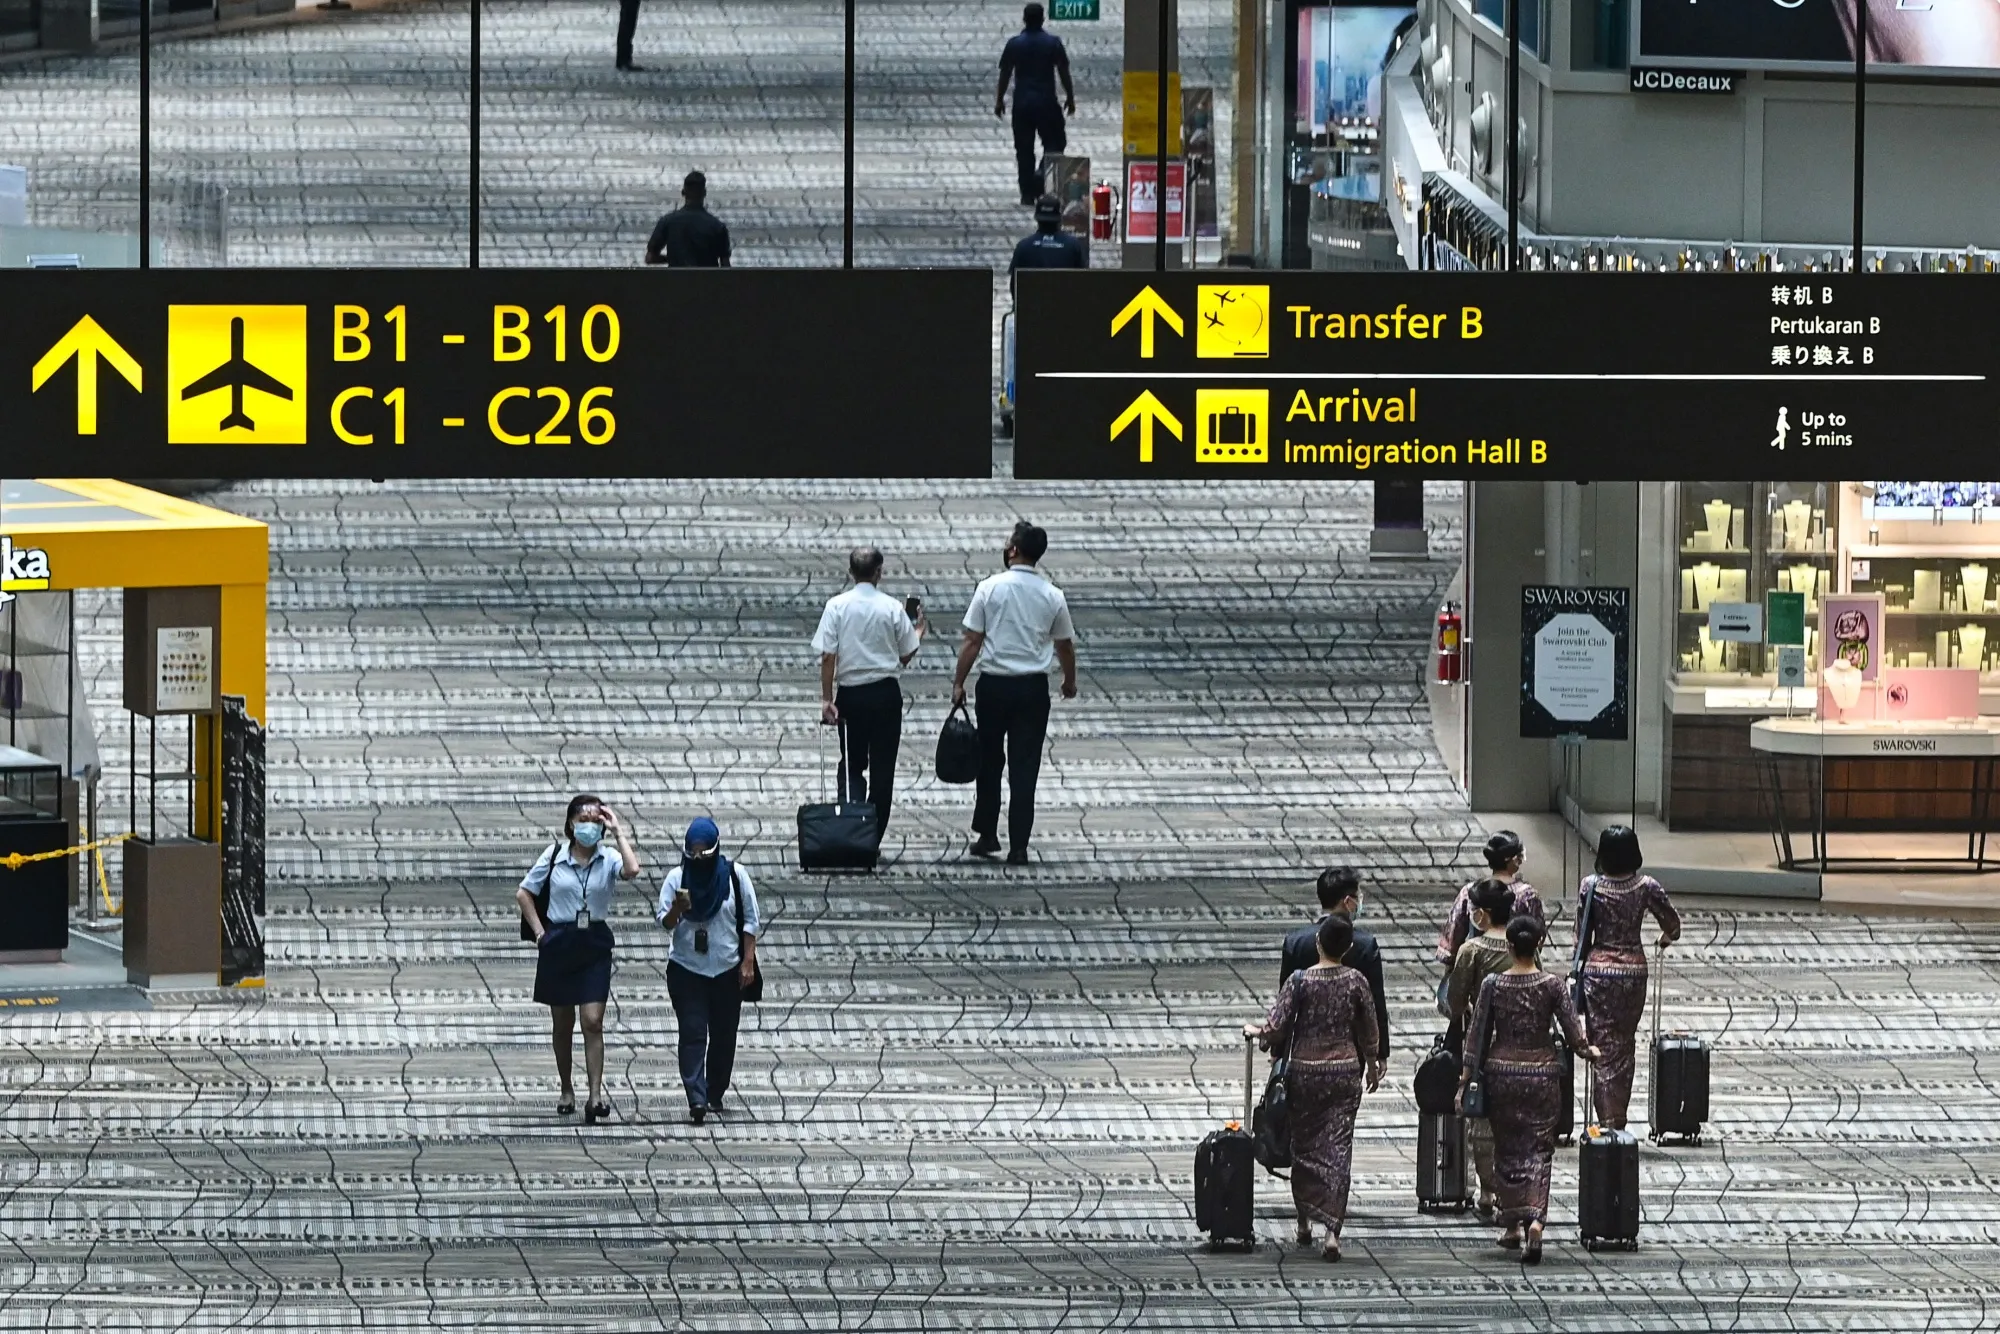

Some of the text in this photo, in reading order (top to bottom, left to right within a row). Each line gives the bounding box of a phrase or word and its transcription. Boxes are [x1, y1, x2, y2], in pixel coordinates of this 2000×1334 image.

[1055, 2, 1083, 18] EXIT
[1634, 71, 1732, 92] JCDecaux
[1771, 285, 1833, 305] 转机 B
[1286, 304, 1484, 339] Transfer B
[1771, 315, 1881, 334] Pertukaran B
[333, 304, 621, 363] B1 - B10
[1771, 345, 1874, 366] 乗り換え B
[1285, 388, 1416, 422] Arrival
[330, 386, 617, 445] C1 - C26
[1802, 411, 1846, 430] Up to
[1802, 431, 1853, 446] 5 mins
[1284, 438, 1547, 469] Immigration Hall B
[1524, 588, 1627, 607] SWAROVSKI
[1557, 627, 1591, 637] Join the
[1542, 637, 1608, 647] Swarovski Club
[1873, 739, 1937, 752] SWAROVSKI
